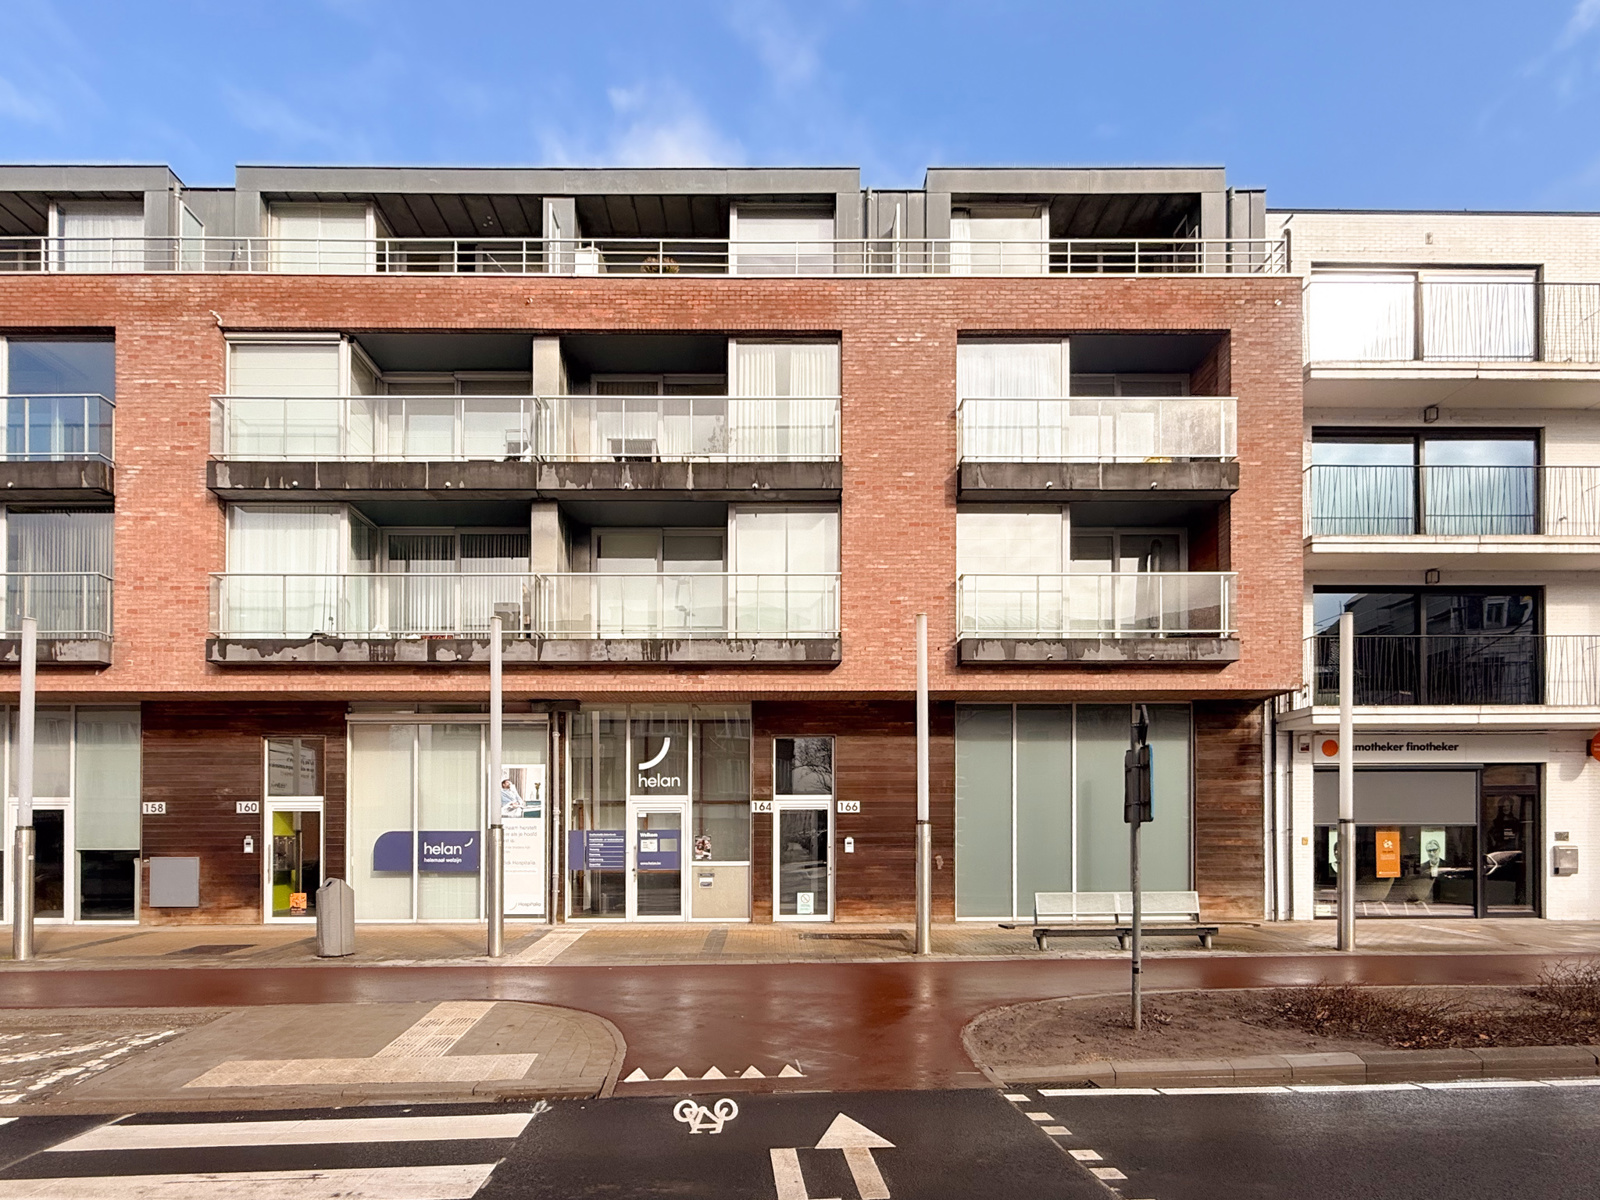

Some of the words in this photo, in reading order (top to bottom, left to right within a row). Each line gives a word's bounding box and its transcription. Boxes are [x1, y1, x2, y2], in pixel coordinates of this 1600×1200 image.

[1353, 741, 1404, 751] motheker
[1406, 741, 1459, 751] finotheker
[638, 772, 681, 788] helan
[144, 803, 164, 813] 158
[238, 802, 257, 812] 160
[753, 802, 772, 811] 164
[839, 802, 858, 811] 166
[423, 841, 462, 855] helan
